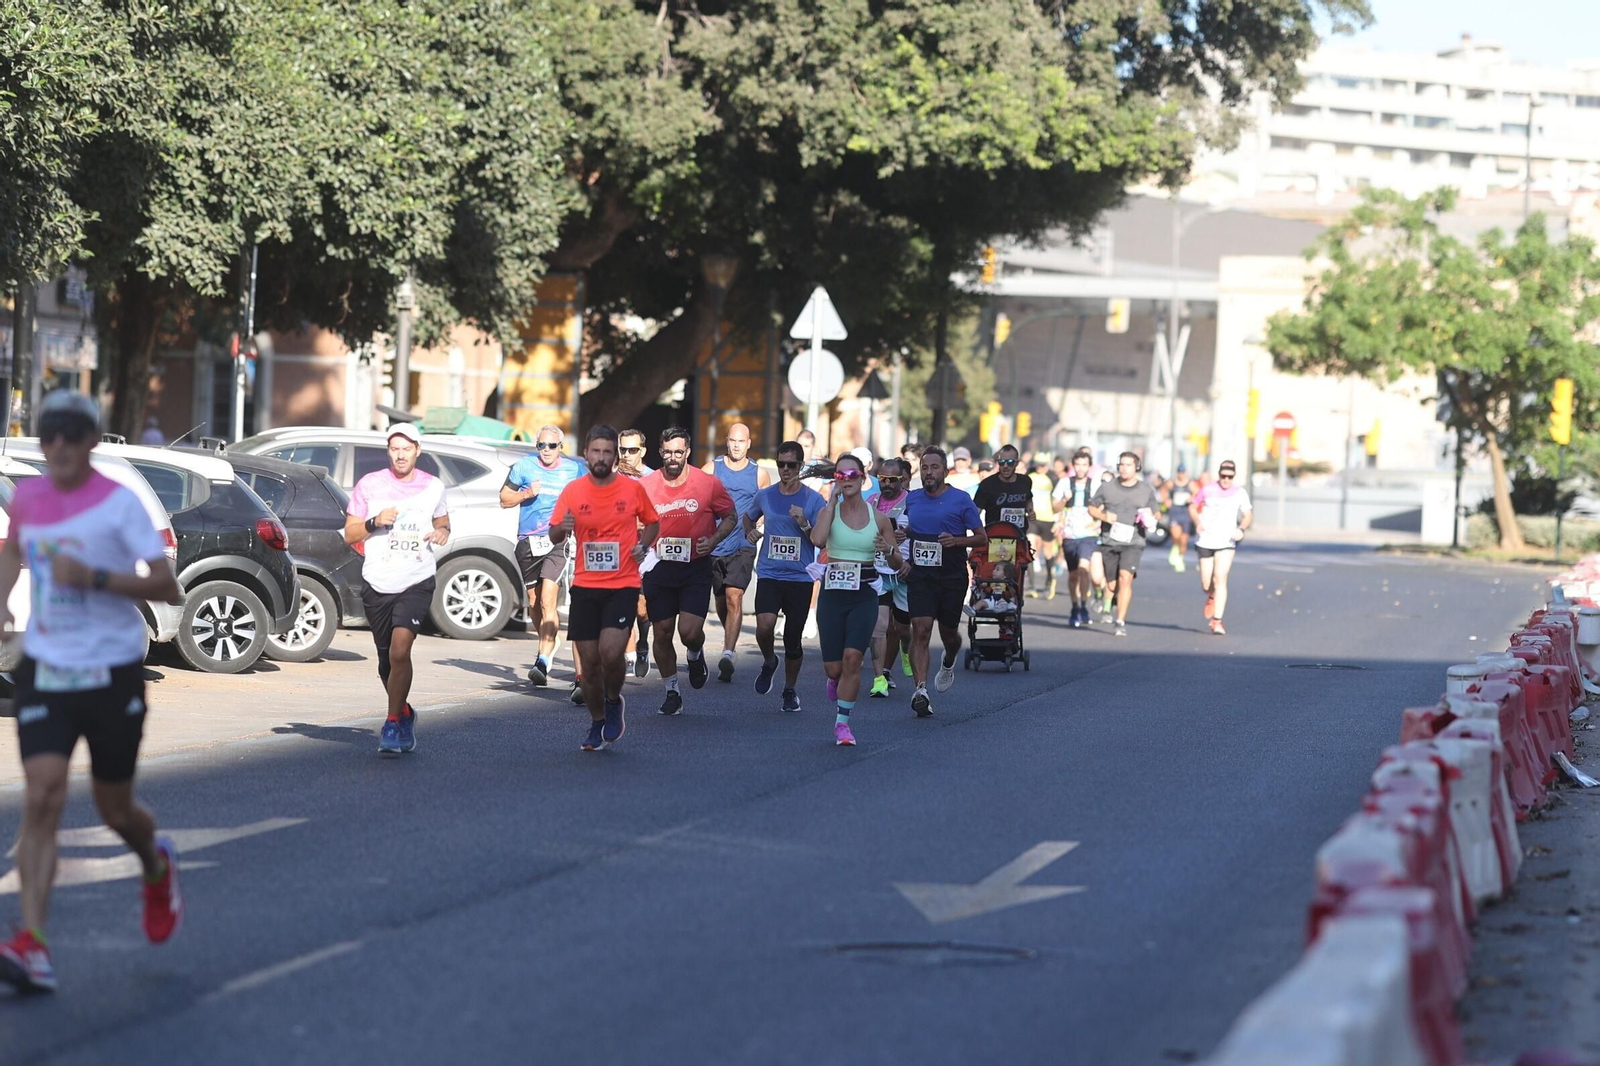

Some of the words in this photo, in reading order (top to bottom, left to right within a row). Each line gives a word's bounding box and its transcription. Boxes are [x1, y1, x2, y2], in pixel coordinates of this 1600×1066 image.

[1005, 515, 1022, 523] 697
[390, 539, 419, 552] 202
[665, 545, 682, 554] 20
[774, 544, 795, 554] 108
[588, 552, 613, 563] 585
[915, 549, 936, 560] 547
[829, 570, 855, 582] 632
